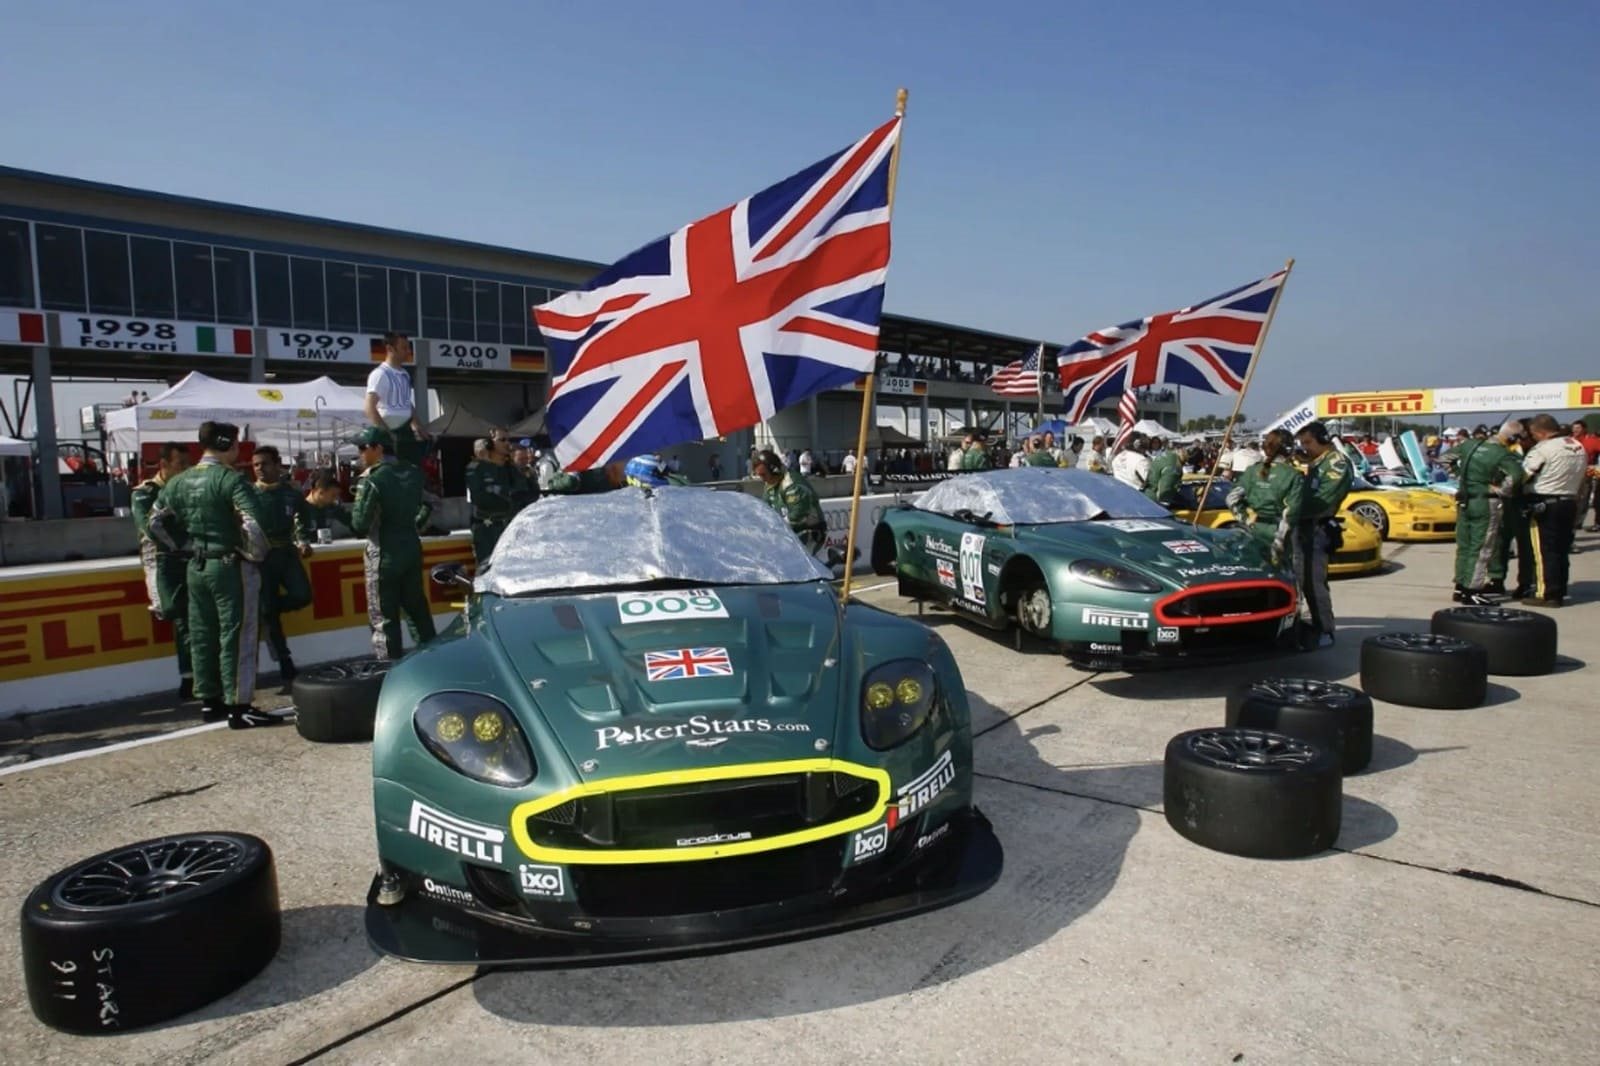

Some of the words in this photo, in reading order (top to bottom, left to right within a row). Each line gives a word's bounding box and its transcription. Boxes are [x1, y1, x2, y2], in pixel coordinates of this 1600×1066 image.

[78, 318, 176, 340] 1998
[80, 336, 177, 352] Ferrari
[280, 332, 354, 350] 1999
[439, 343, 498, 360] 2000
[297, 349, 340, 361] BMW
[457, 357, 483, 369] Audi
[1327, 393, 1424, 415] PIRELLI
[960, 549, 981, 585] 007
[621, 596, 721, 617] 009
[1082, 608, 1149, 629] PIRELLI
[897, 749, 956, 820] PIRELLI
[409, 799, 505, 864] PIRELLI
[855, 833, 884, 856] ixo
[519, 864, 558, 890] ixo
[424, 878, 473, 902] Ontime
